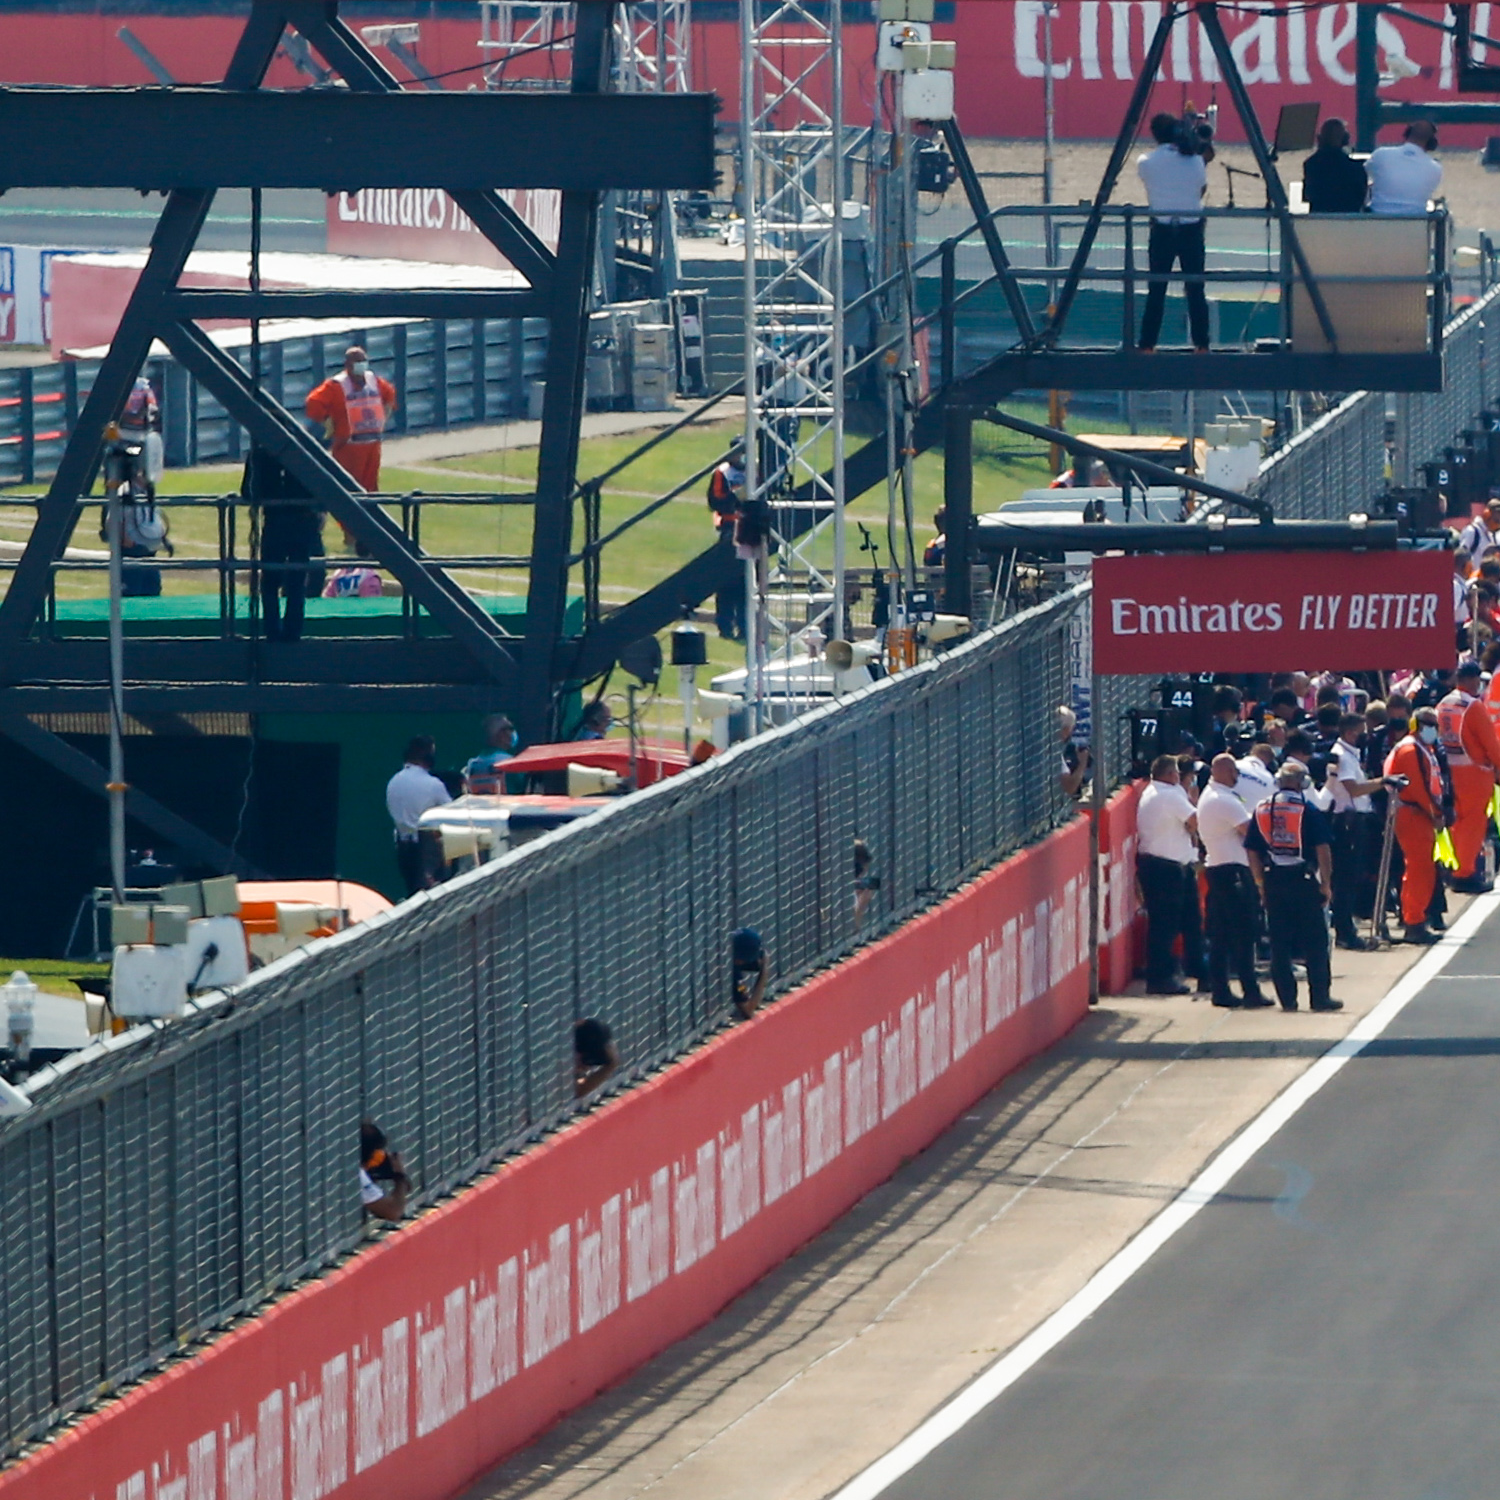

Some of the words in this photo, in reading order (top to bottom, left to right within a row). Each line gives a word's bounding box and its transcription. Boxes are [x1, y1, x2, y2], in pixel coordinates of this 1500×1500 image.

[1111, 596, 1283, 635] Emirates
[1299, 596, 1343, 630] FLY
[1348, 593, 1438, 630] BETTER
[1171, 691, 1193, 707] 44
[1140, 719, 1157, 735] 77
